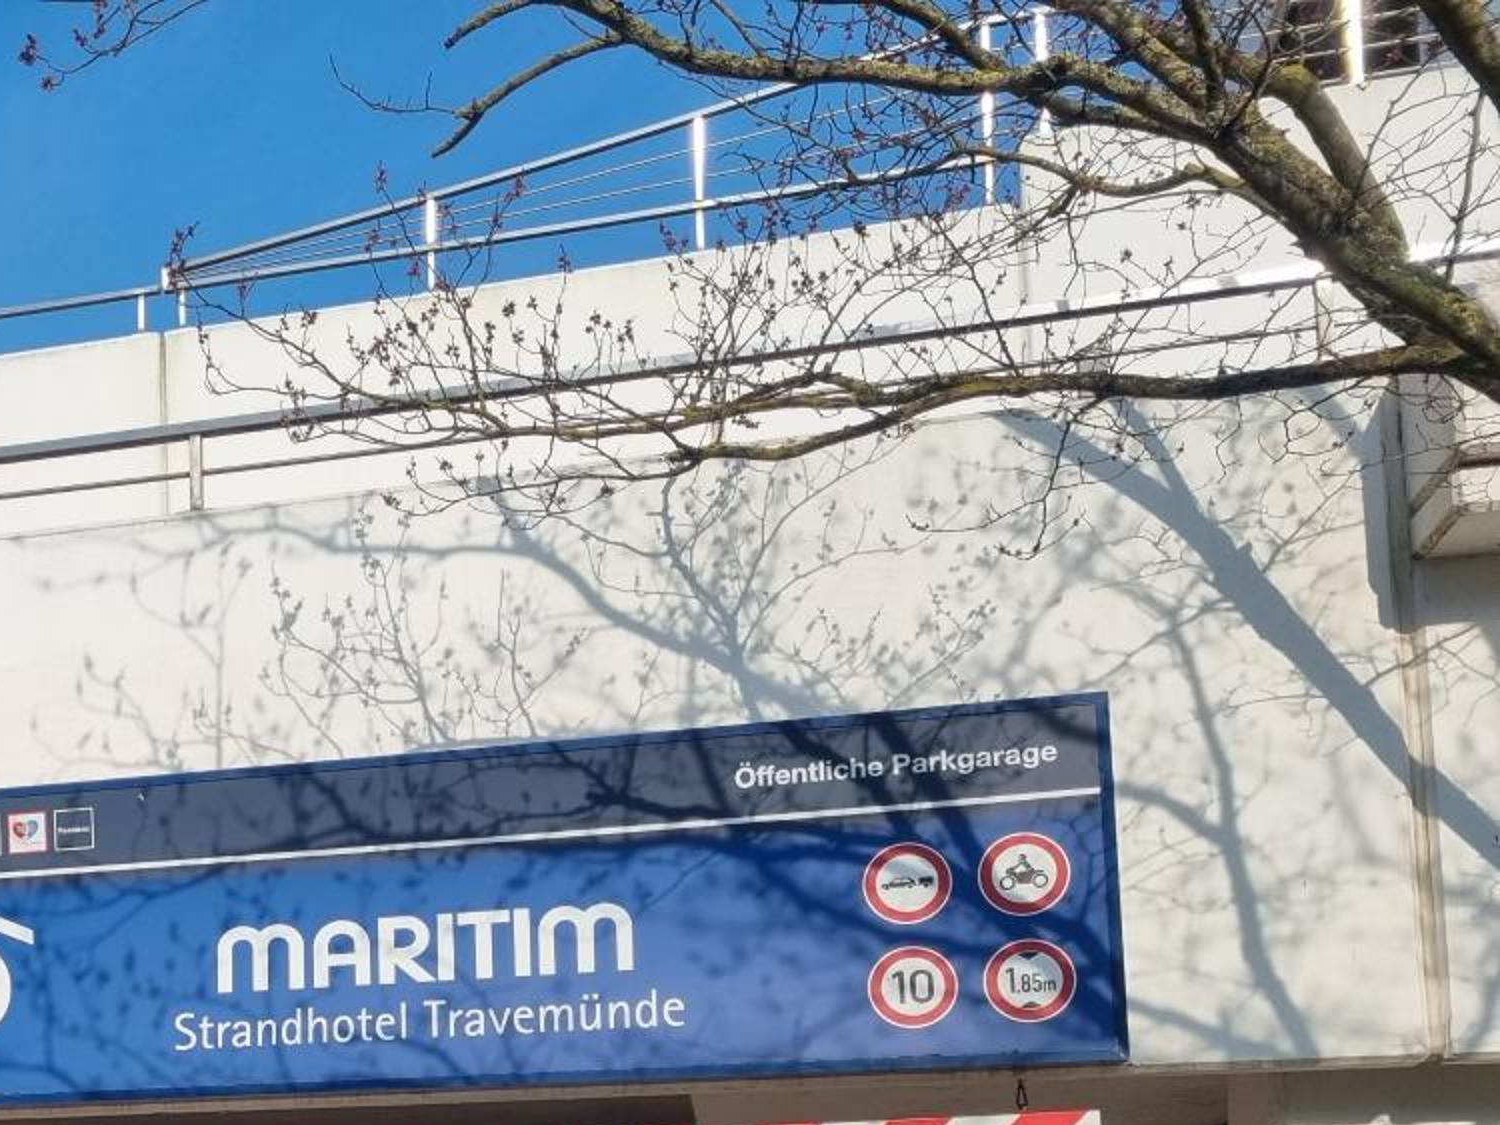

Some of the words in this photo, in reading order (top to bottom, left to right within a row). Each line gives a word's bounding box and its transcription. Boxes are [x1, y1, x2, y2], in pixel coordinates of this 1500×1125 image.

[734, 757, 884, 788] Öffentliche
[892, 745, 1058, 775] Parkgarage
[217, 902, 635, 994] MARITIM
[891, 969, 935, 1004] 10
[1005, 967, 1057, 994] 1.85m
[173, 1002, 408, 1051] Strandhotel
[422, 989, 685, 1040] Travemünde
